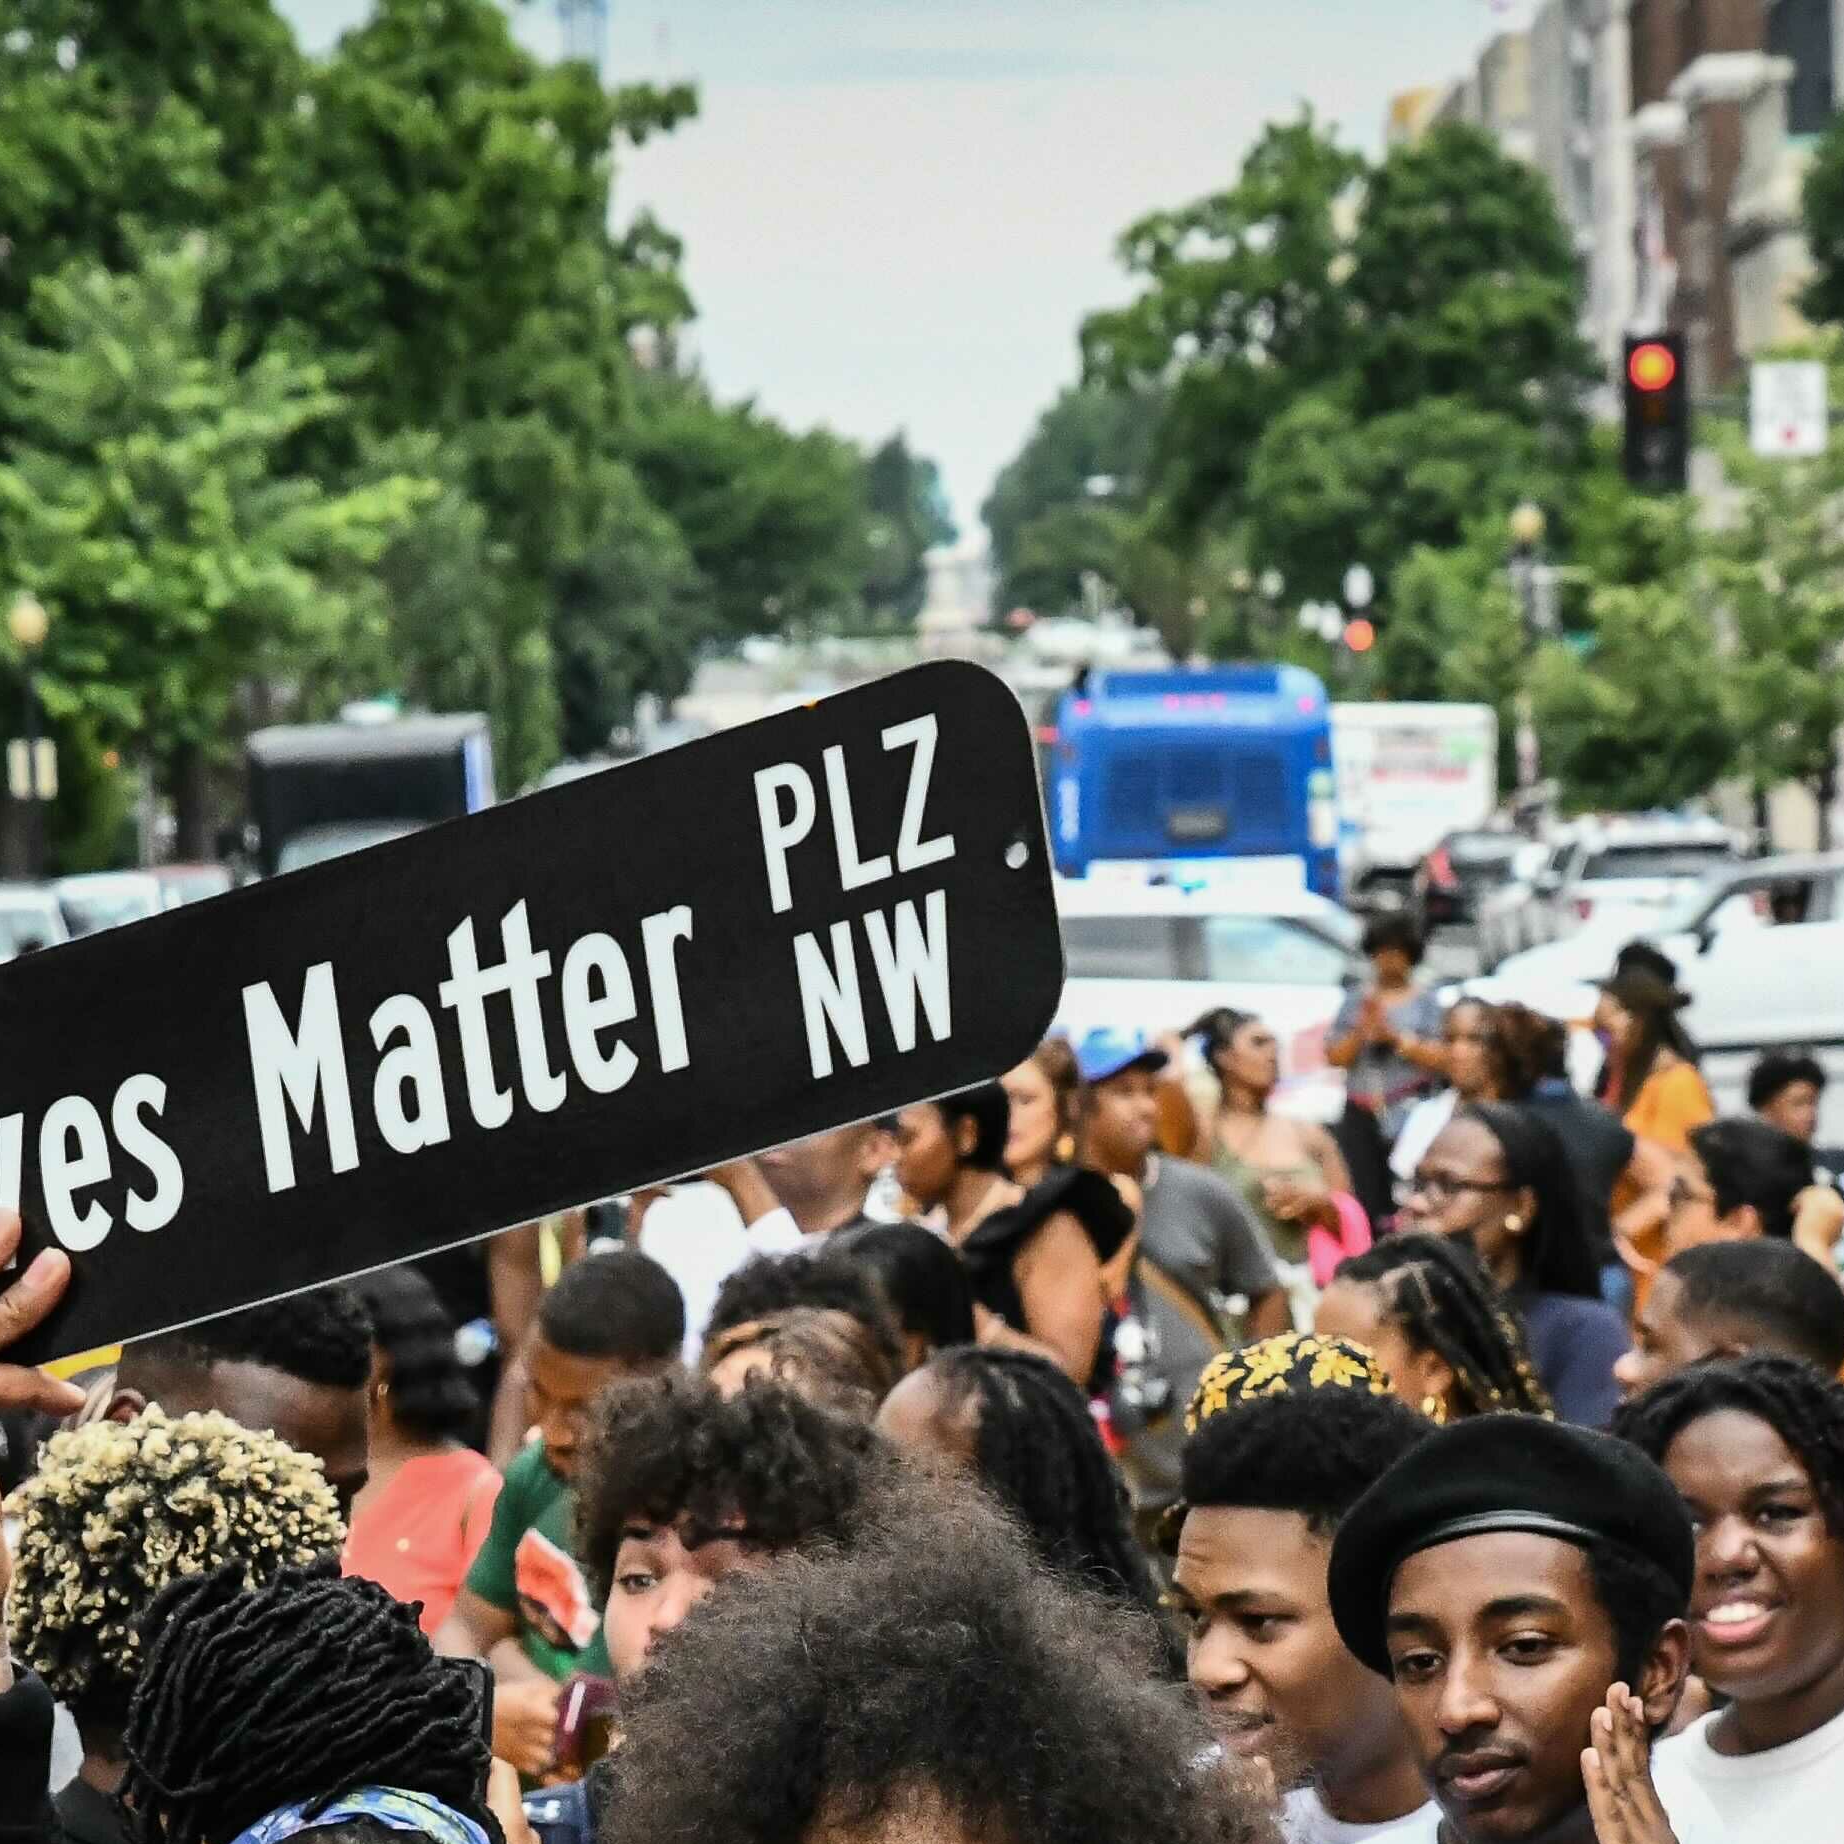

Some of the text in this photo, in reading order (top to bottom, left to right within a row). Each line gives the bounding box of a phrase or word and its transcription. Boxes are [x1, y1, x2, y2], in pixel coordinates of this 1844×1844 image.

[753, 714, 956, 913] PLZ
[241, 897, 693, 1193] Matter
[792, 888, 953, 1080] NW
